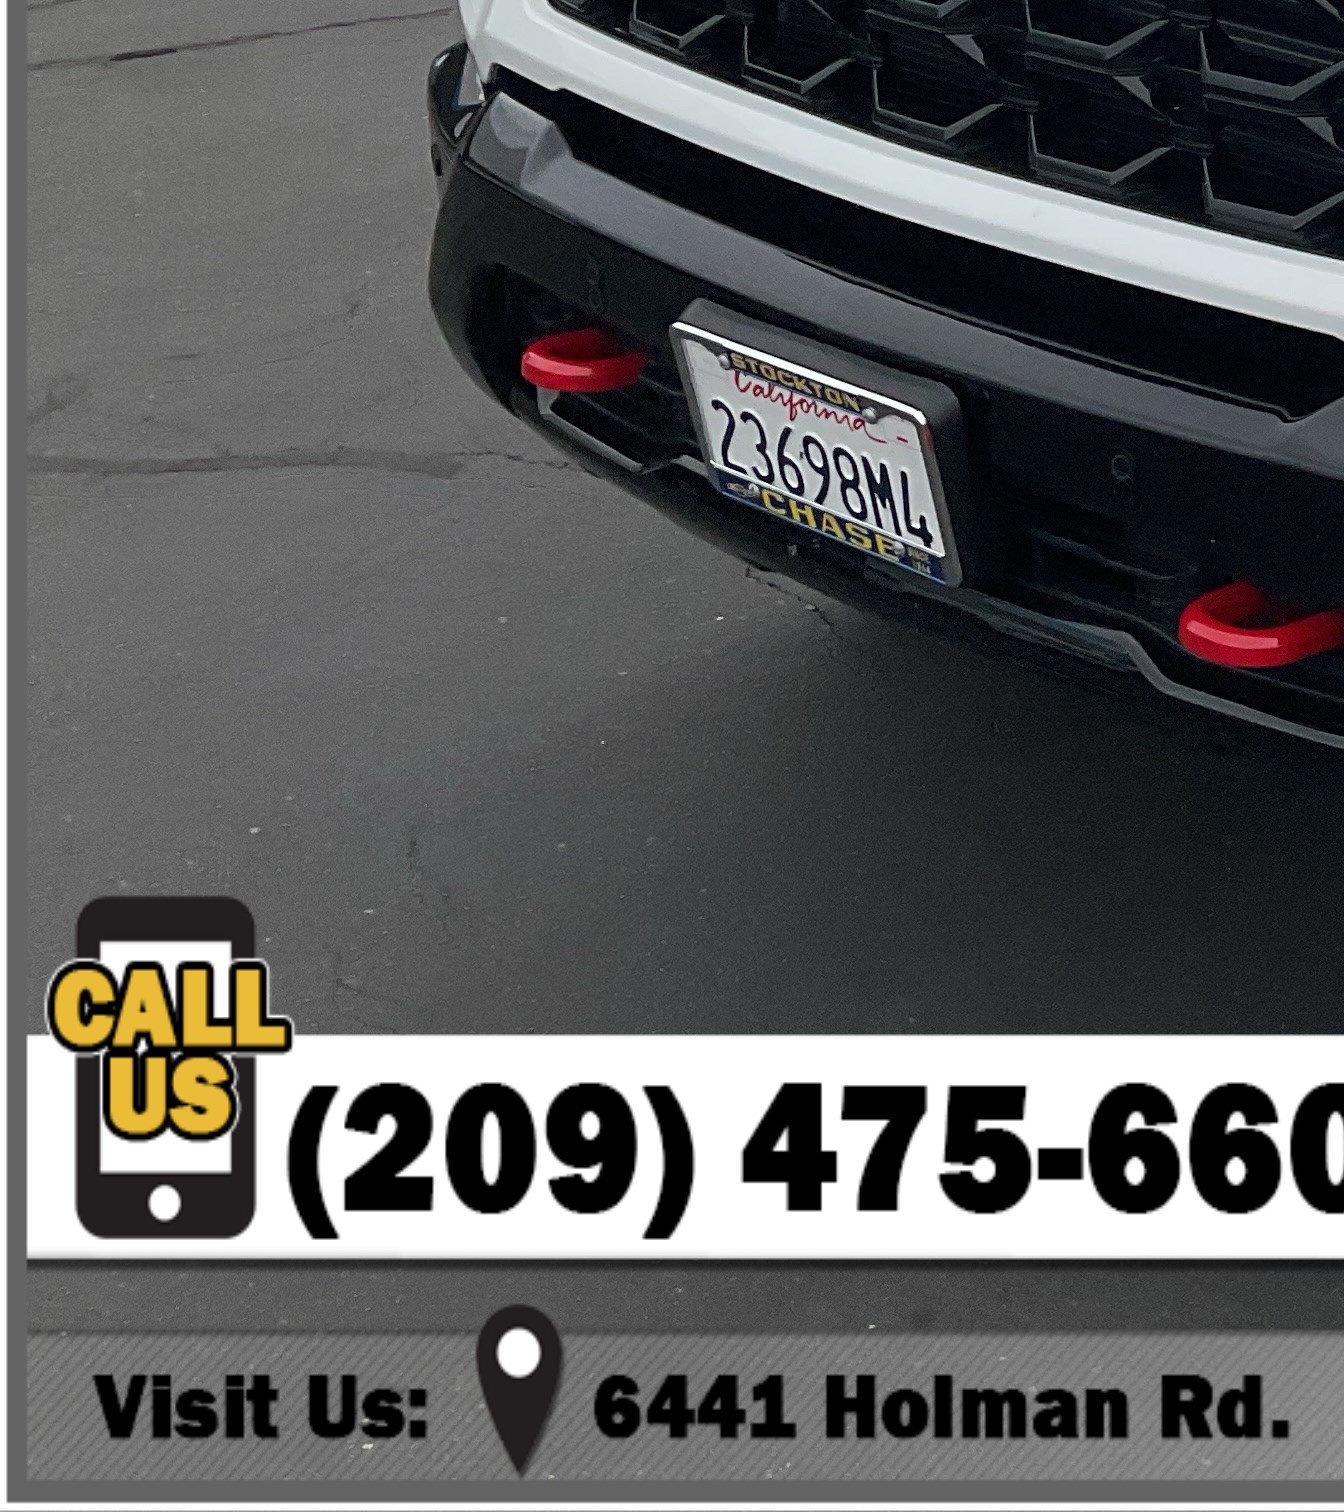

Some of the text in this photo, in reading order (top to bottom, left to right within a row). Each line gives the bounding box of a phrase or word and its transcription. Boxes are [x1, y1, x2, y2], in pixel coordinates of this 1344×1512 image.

[730, 351, 861, 413] STOCKTON
[733, 369, 887, 444] California
[710, 398, 934, 550] 23698M4
[760, 486, 905, 561] CHASE
